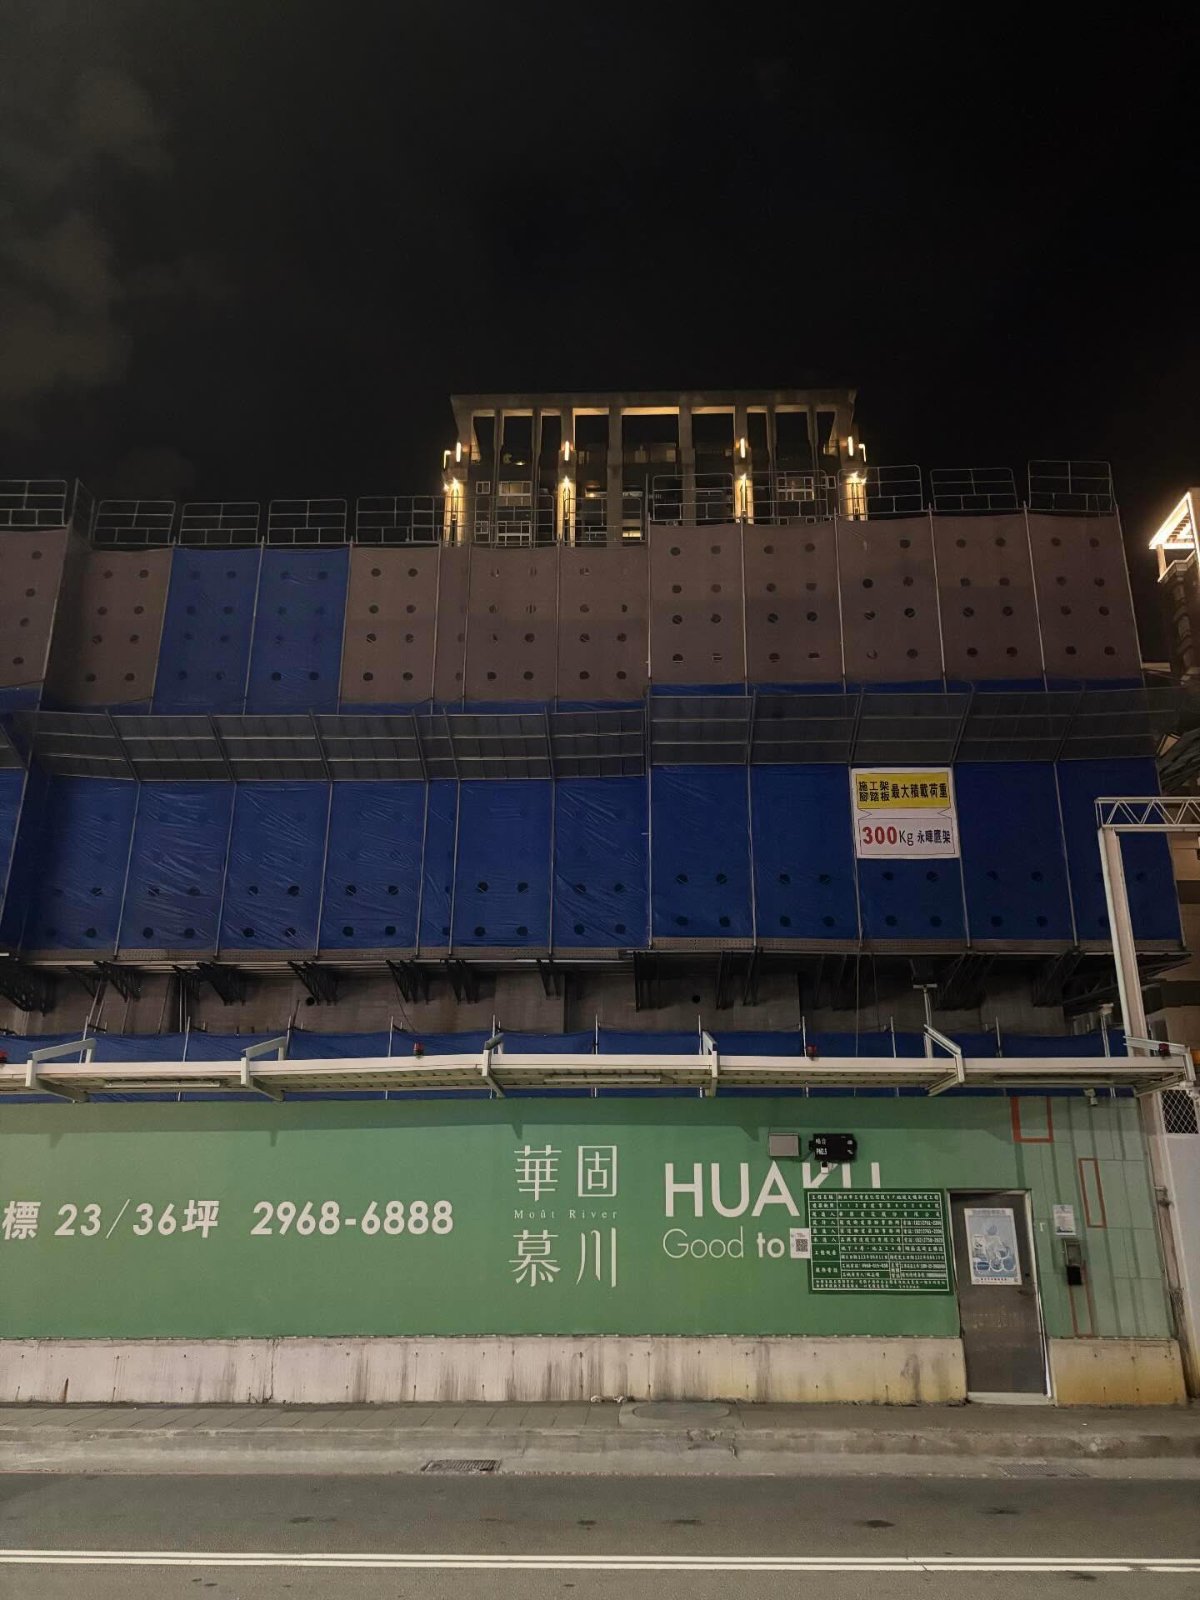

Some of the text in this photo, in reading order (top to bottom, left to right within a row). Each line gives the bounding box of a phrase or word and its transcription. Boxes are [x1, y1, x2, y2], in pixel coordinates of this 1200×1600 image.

[514, 1145, 618, 1202] 華固
[2, 1200, 41, 1240] 標
[250, 1200, 453, 1235] 2968-6888
[569, 1209, 618, 1219] River
[509, 1227, 617, 1288] 慕川
[662, 1226, 785, 1259] Good to
